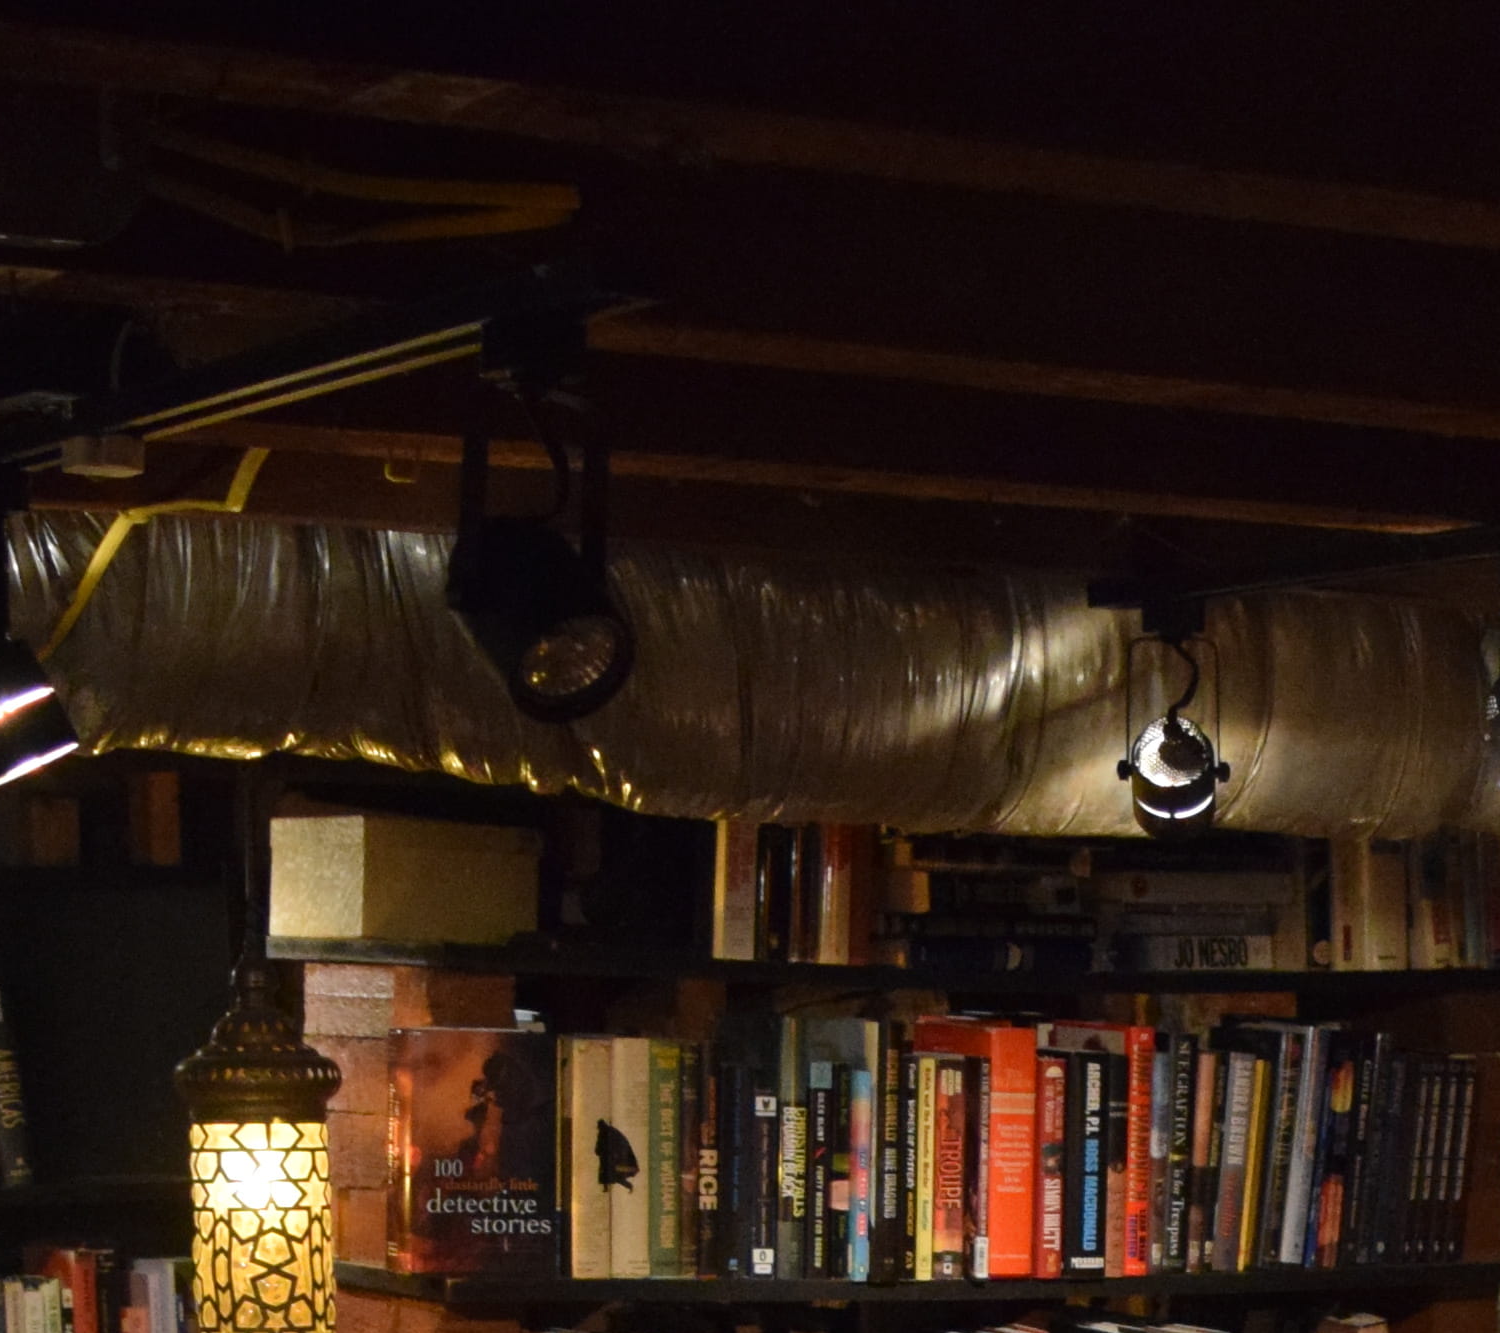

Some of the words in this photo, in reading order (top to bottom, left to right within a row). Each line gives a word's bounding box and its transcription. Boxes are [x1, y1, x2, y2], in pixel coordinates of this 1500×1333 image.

[1176, 1040, 1191, 1070] SUE
[1083, 1062, 1102, 1115] ARCHER,
[1173, 1072, 1189, 1147] GRAFTON
[434, 1158, 464, 1178] 100
[1084, 1138, 1099, 1172] ROSS
[507, 1176, 539, 1191] little
[699, 1148, 718, 1211] RICE
[940, 1137, 962, 1209] TROUPE
[1172, 1179, 1185, 1196] for
[426, 1187, 538, 1216] detective
[1082, 1174, 1098, 1252] MACDONALD
[470, 1211, 553, 1237] stories
[1167, 1197, 1185, 1257] Trespass
